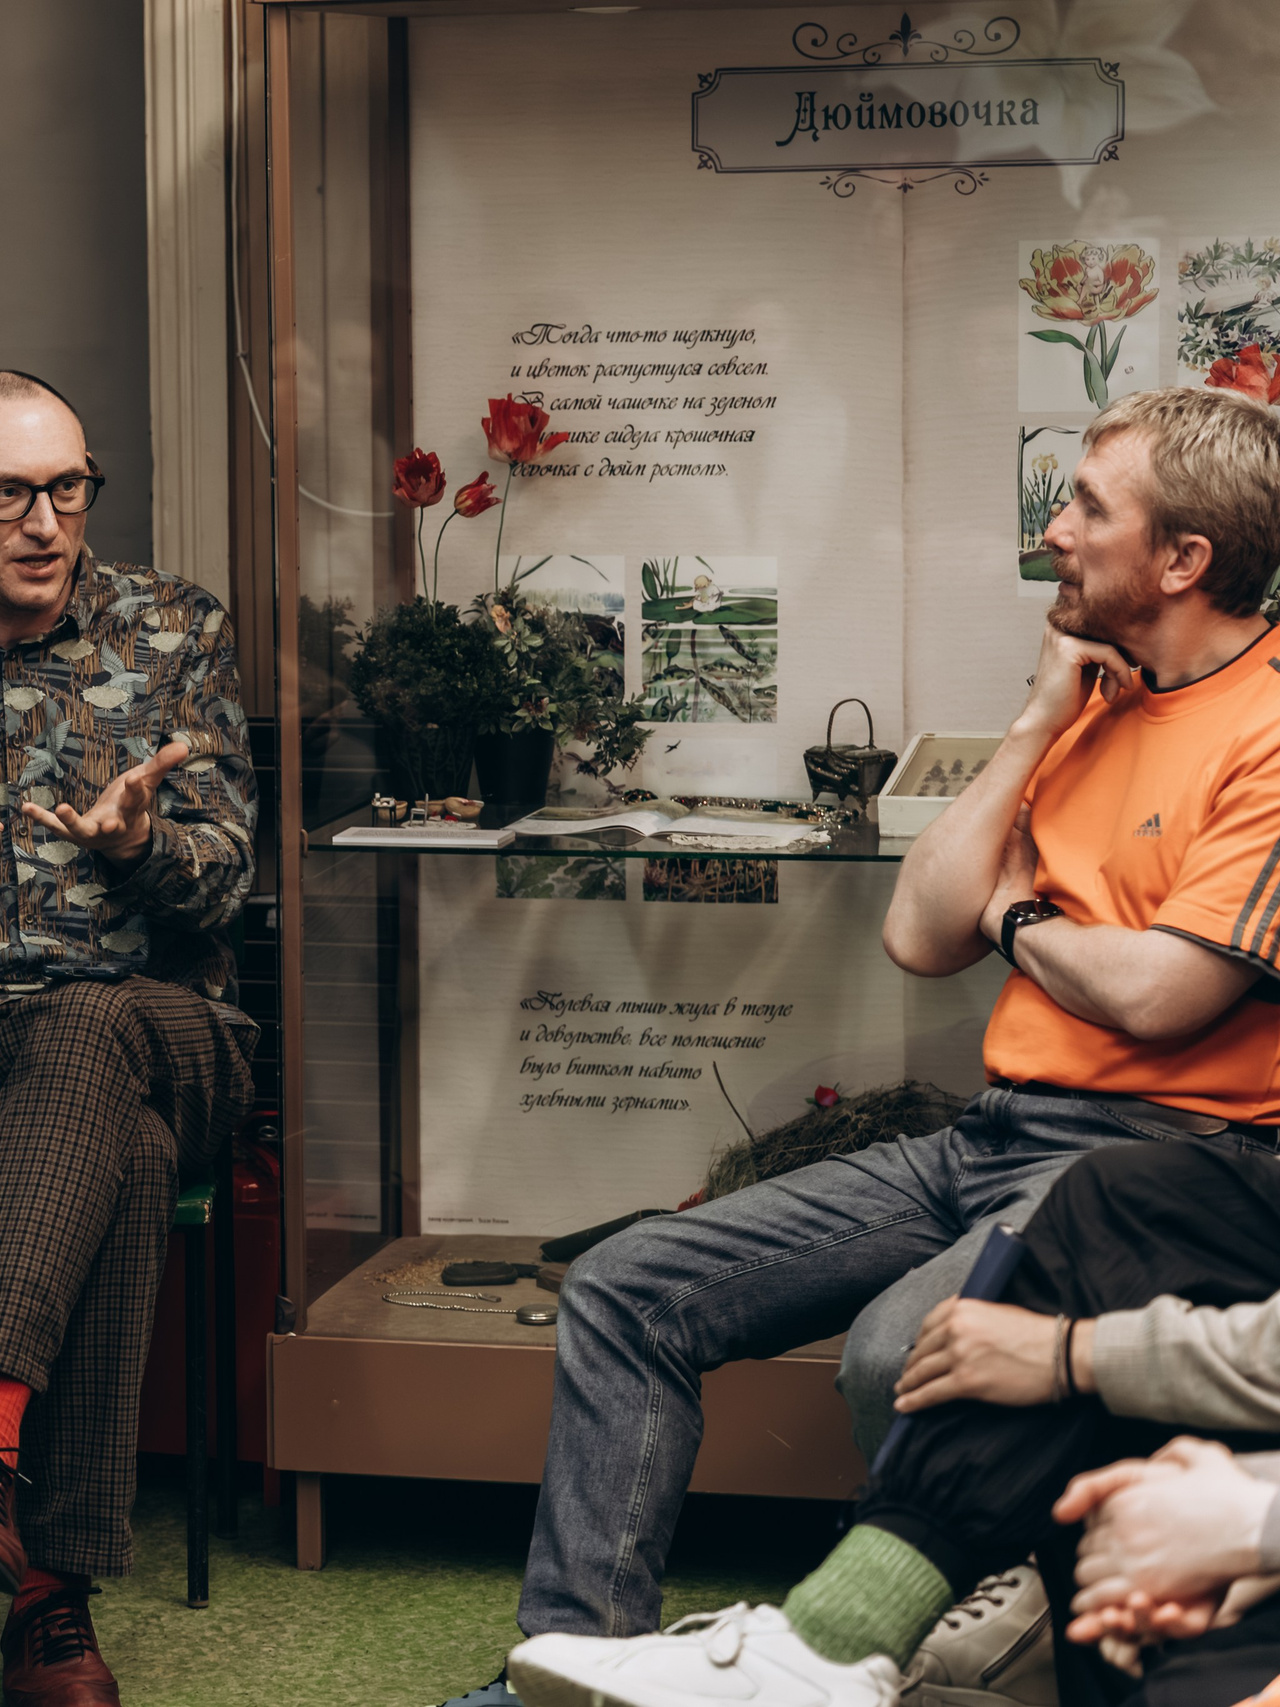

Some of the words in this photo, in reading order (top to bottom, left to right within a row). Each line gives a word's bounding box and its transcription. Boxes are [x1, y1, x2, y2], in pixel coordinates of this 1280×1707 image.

[775, 91, 1040, 147] Дюймовочка
[512, 323, 602, 345] «Тогда
[606, 330, 667, 343] что-то
[672, 328, 756, 349] щелкнуло,
[510, 365, 521, 378] и
[526, 358, 590, 379] цветок
[593, 362, 703, 384] распустился
[707, 355, 769, 376] совсем.
[550, 394, 602, 410] самой
[607, 397, 678, 410] чашечке
[682, 396, 706, 409] на
[705, 396, 777, 417] зеленом
[604, 424, 661, 450] сидела
[665, 430, 756, 450] крошечная
[583, 464, 594, 477] с
[599, 457, 646, 477] дюйм
[649, 462, 729, 483] ростом».
[520, 990, 611, 1018] «Полевая
[616, 1000, 667, 1014] мышь
[669, 1001, 720, 1022] жила
[723, 997, 738, 1017] в
[741, 1003, 794, 1023] тепле
[520, 1030, 531, 1042] и
[638, 1027, 667, 1047] все
[671, 1034, 766, 1050] помещение
[520, 1055, 561, 1081] было
[566, 1056, 634, 1077] битком
[638, 1060, 702, 1080] набито
[519, 1088, 606, 1113] хлебными
